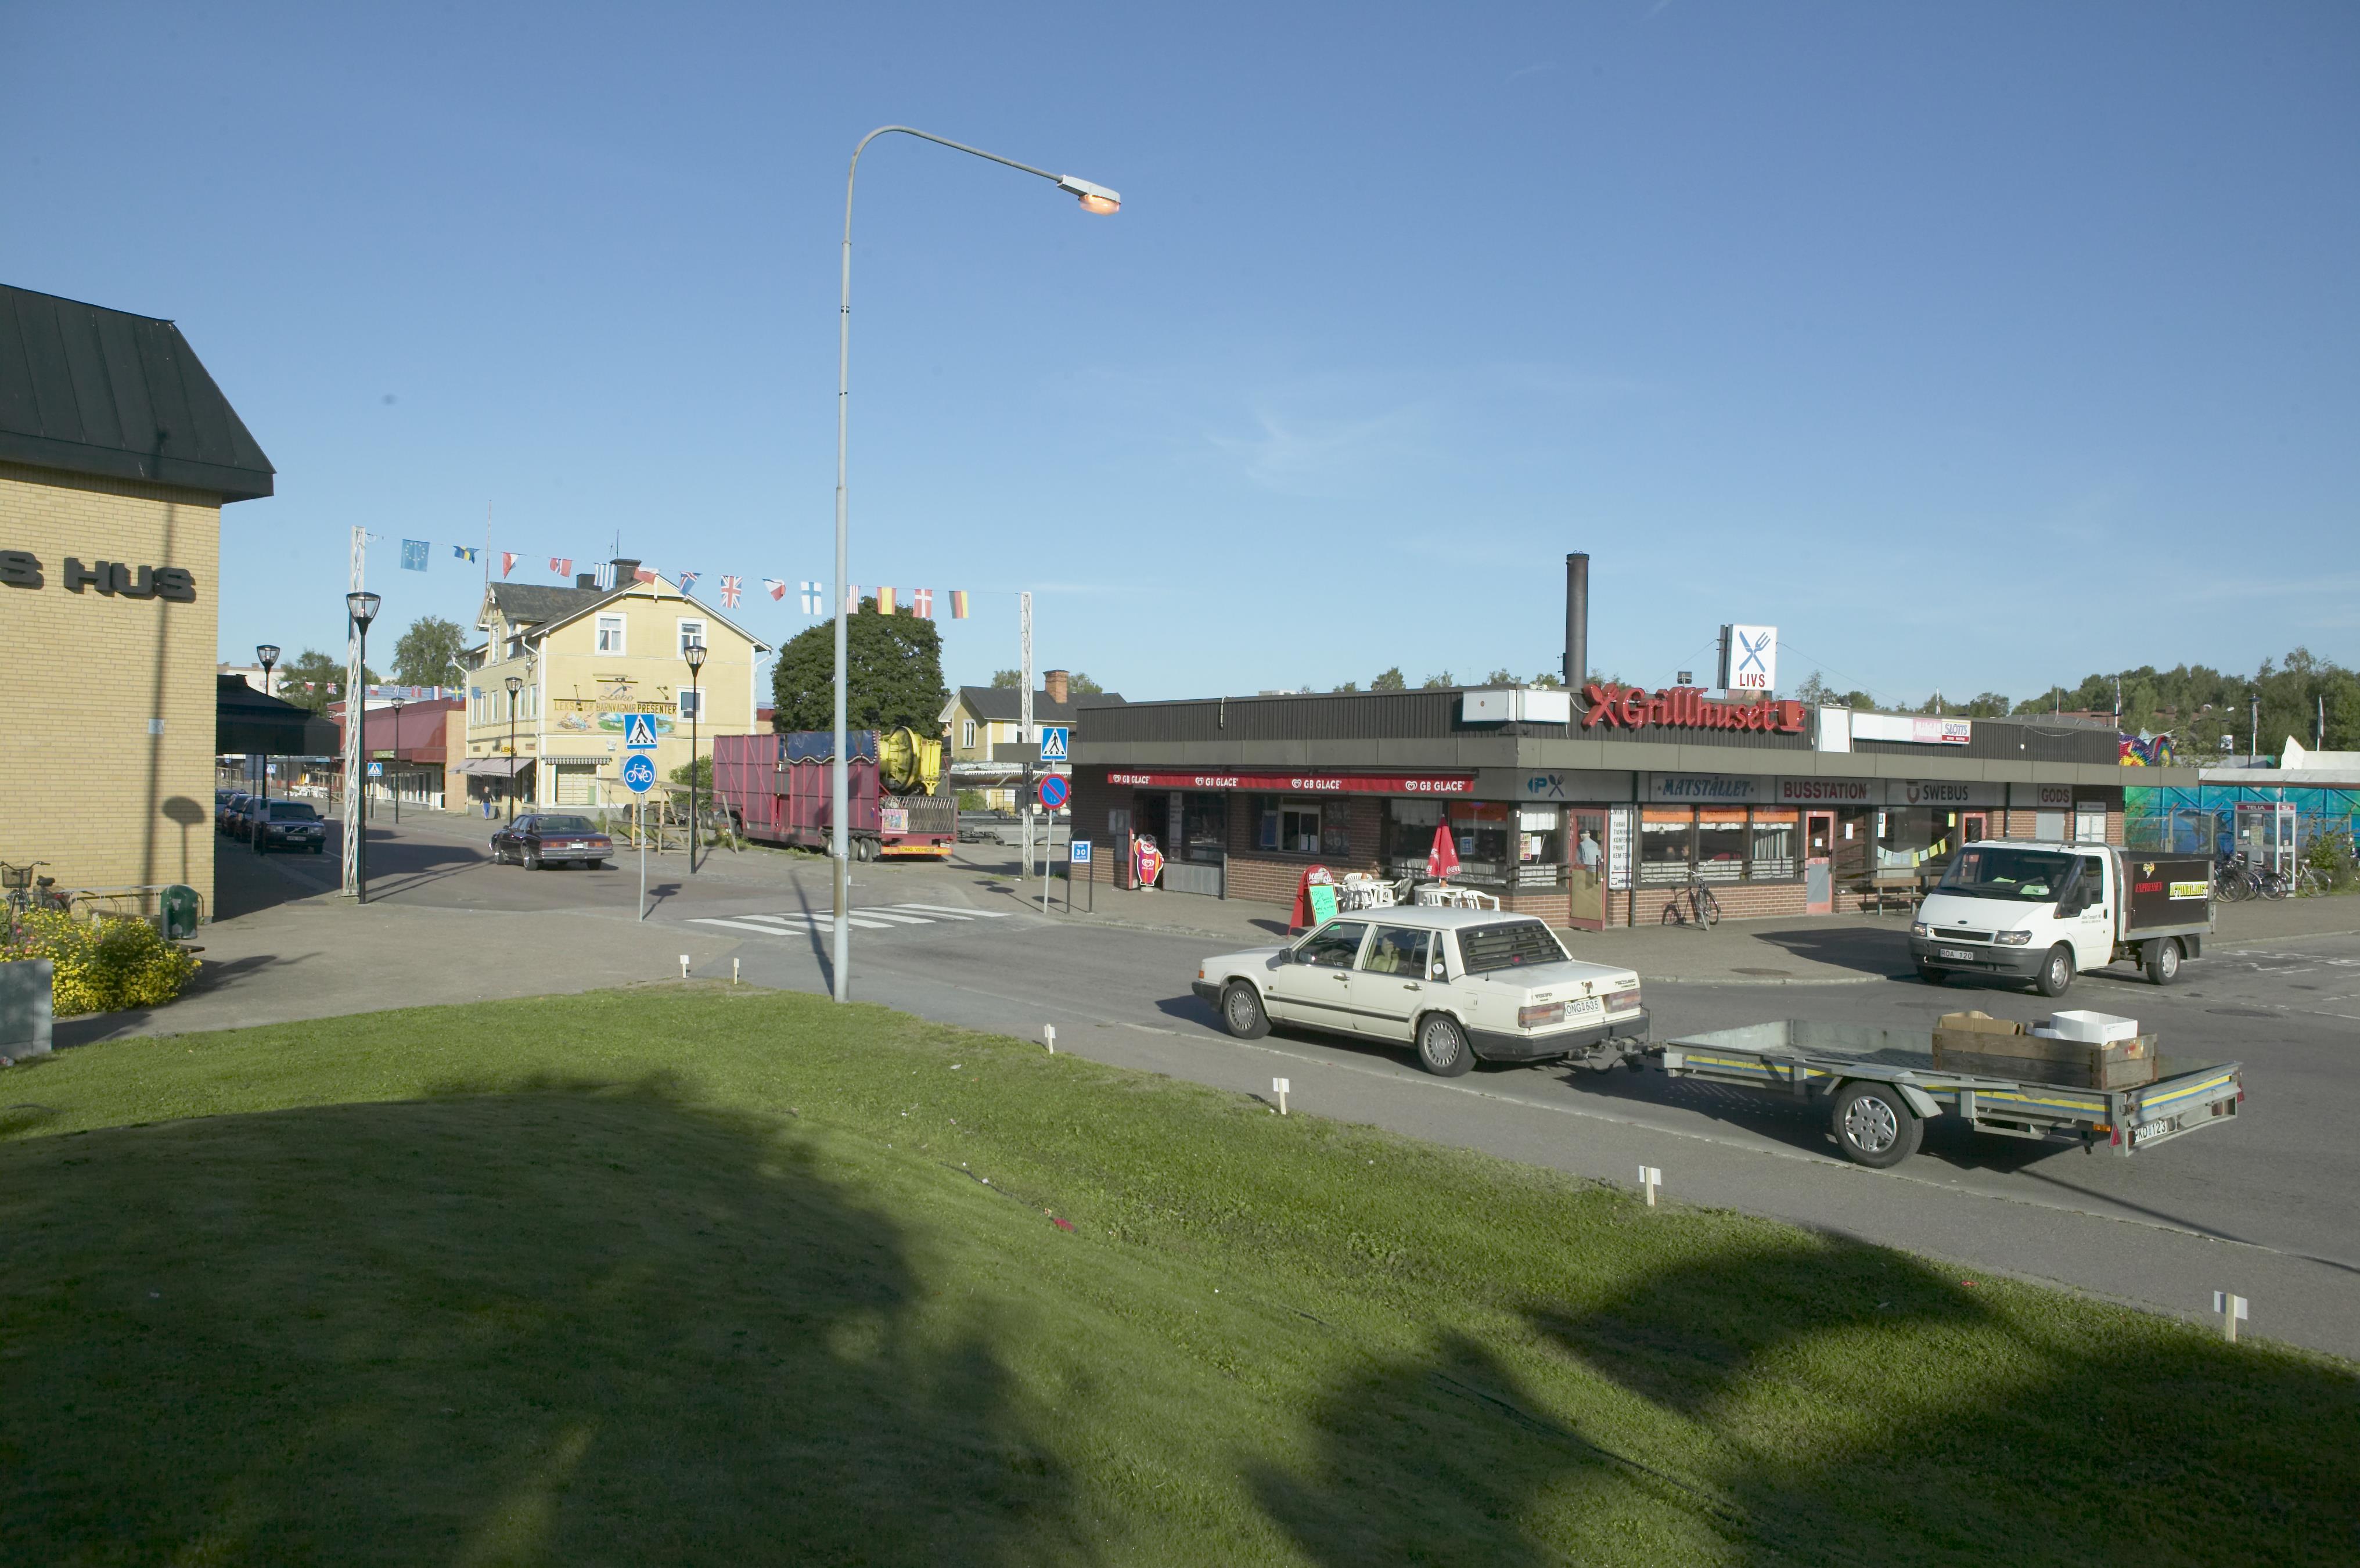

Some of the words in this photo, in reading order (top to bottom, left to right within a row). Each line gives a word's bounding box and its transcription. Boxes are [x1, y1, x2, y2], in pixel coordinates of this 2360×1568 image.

[64, 558, 195, 601] HUS
[1739, 674, 1765, 688] LIVS
[596, 703, 636, 713] BARNVAGNAR
[638, 704, 677, 714] PRESENTER
[1615, 686, 1778, 730] Grillhuset
[1945, 723, 1967, 735] SLOTTS
[1131, 776, 1149, 784] GLACE
[1206, 778, 1214, 786] GB
[1216, 778, 1236, 786] GLACE
[1304, 779, 1314, 789] GB
[1316, 780, 1340, 789] GLACE
[1420, 781, 1431, 790] GB
[1434, 781, 1462, 791] GLACE
[1663, 776, 1750, 797] MATSTÄLLET
[1784, 781, 1867, 799] BUSSTATION
[1923, 784, 1969, 801] SWEBUS
[2041, 788, 2070, 803] GODS
[1566, 1003, 1582, 1014] ONG
[1586, 1000, 1599, 1010] 635
[2153, 1121, 2166, 1135] 123
